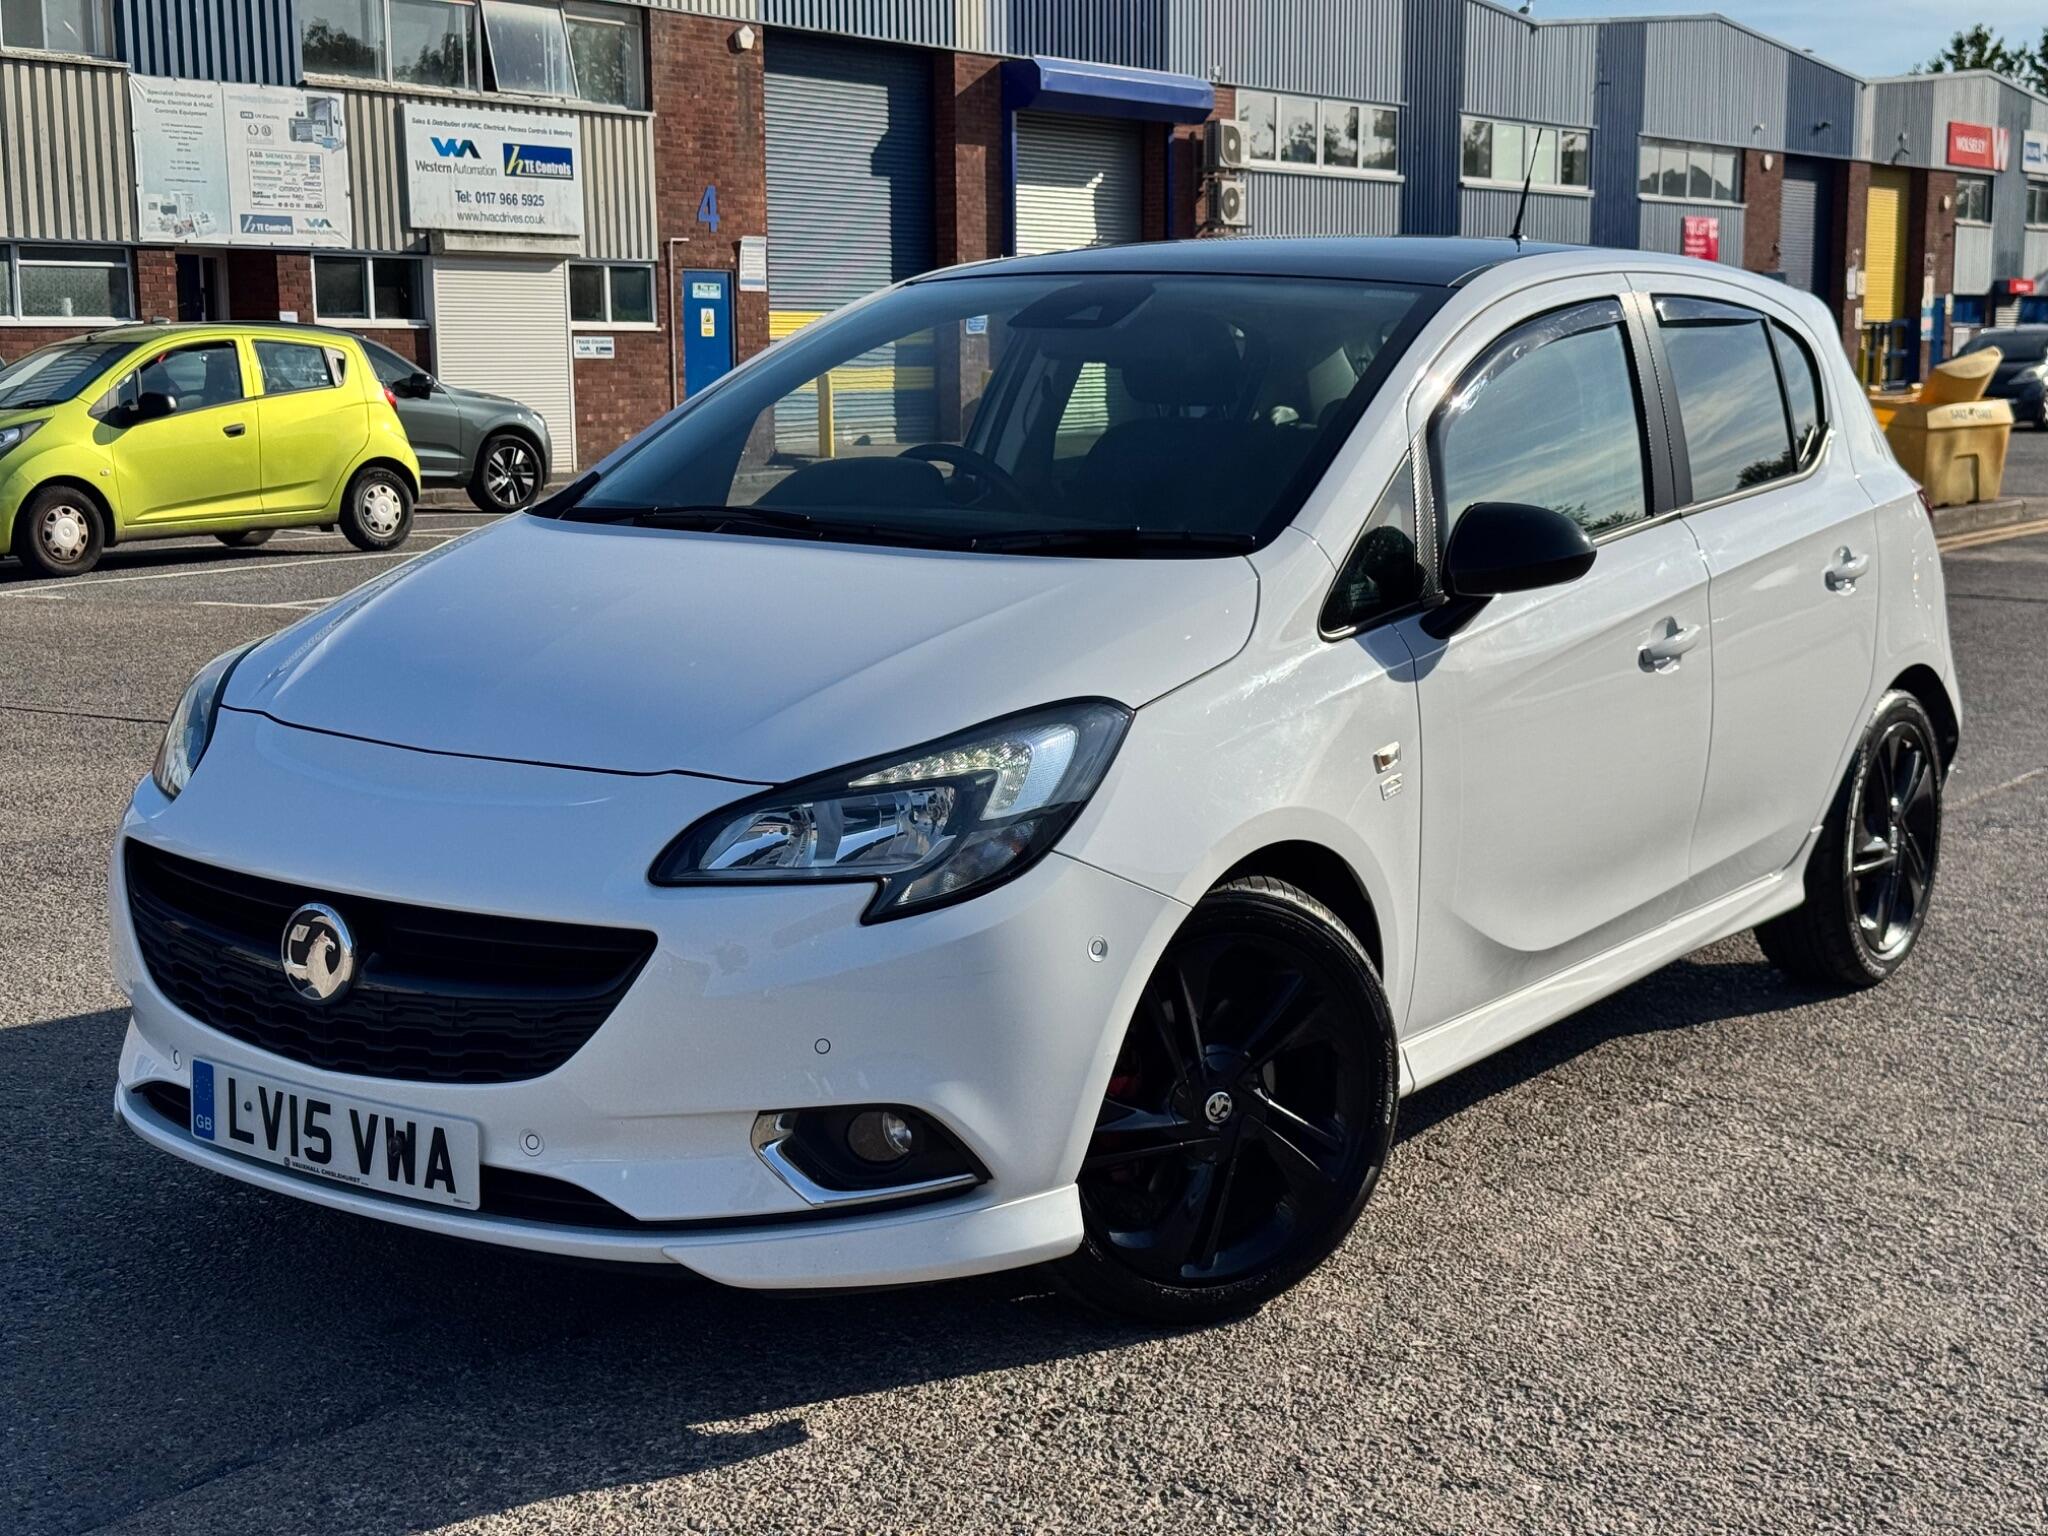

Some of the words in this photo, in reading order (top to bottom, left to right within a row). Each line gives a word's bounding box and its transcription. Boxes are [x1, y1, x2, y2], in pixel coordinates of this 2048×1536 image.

[412, 117, 426, 125] Sales
[432, 119, 460, 128] Distribution
[508, 125, 527, 133] Process
[528, 127, 548, 135] Controls
[553, 129, 573, 138] Metering
[415, 160, 452, 174] Western
[453, 162, 498, 177] Automation
[535, 160, 572, 176] Controls
[455, 190, 472, 203] Tel:
[475, 191, 496, 204] 0117
[499, 192, 519, 206] 966
[521, 193, 545, 207] 5925
[457, 210, 545, 225] www.hvacdrives.co.uk
[698, 185, 720, 233] 4
[196, 1113, 213, 1131] GB
[228, 1077, 333, 1165] LV15
[349, 1108, 457, 1195] VWA
[291, 1160, 321, 1174] VAUXHALL
[321, 1168, 361, 1184] CHISLEHURST
